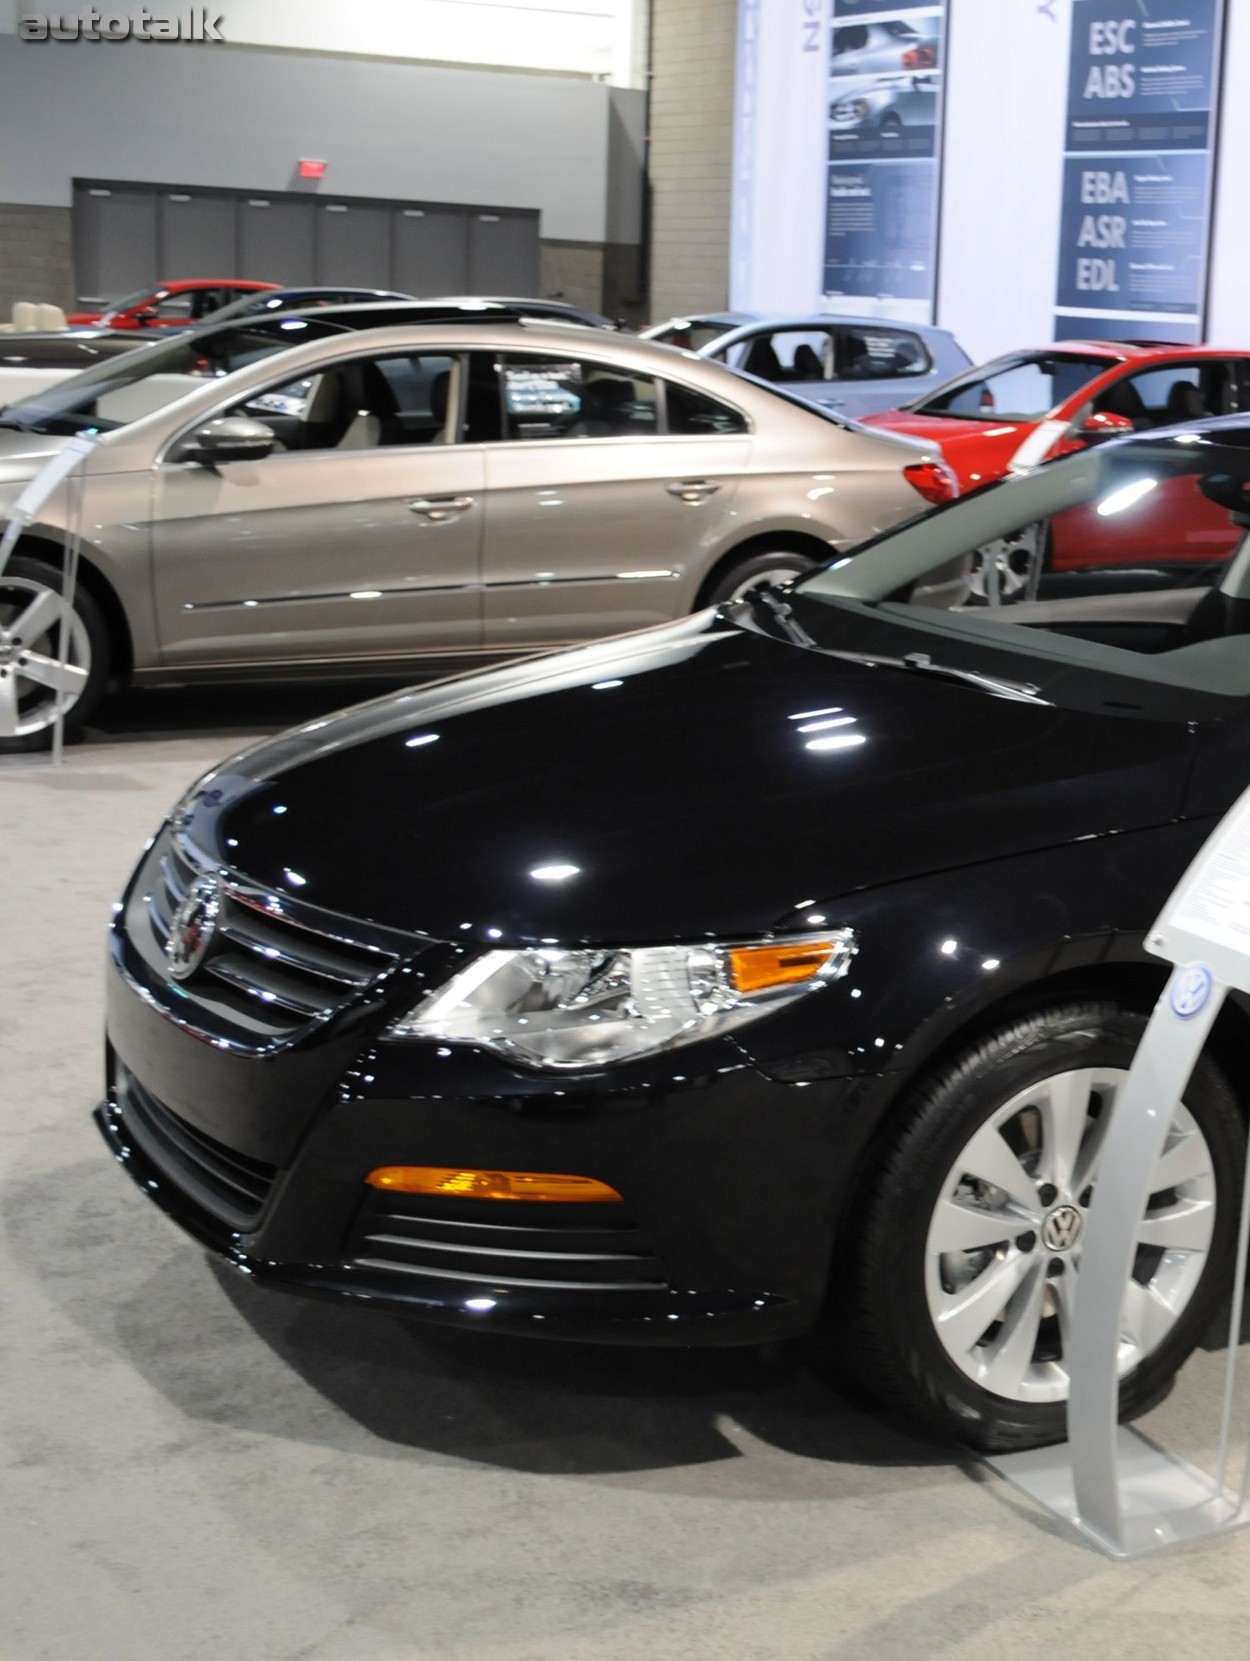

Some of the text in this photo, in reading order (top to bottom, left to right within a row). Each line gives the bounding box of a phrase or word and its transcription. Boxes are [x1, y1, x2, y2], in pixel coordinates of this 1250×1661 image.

[1088, 19, 1136, 55] ESC
[1083, 63, 1136, 99] ABS
[1081, 170, 1130, 204] EBA
[1077, 214, 1126, 249] ASR
[1075, 257, 1120, 292] EDL
